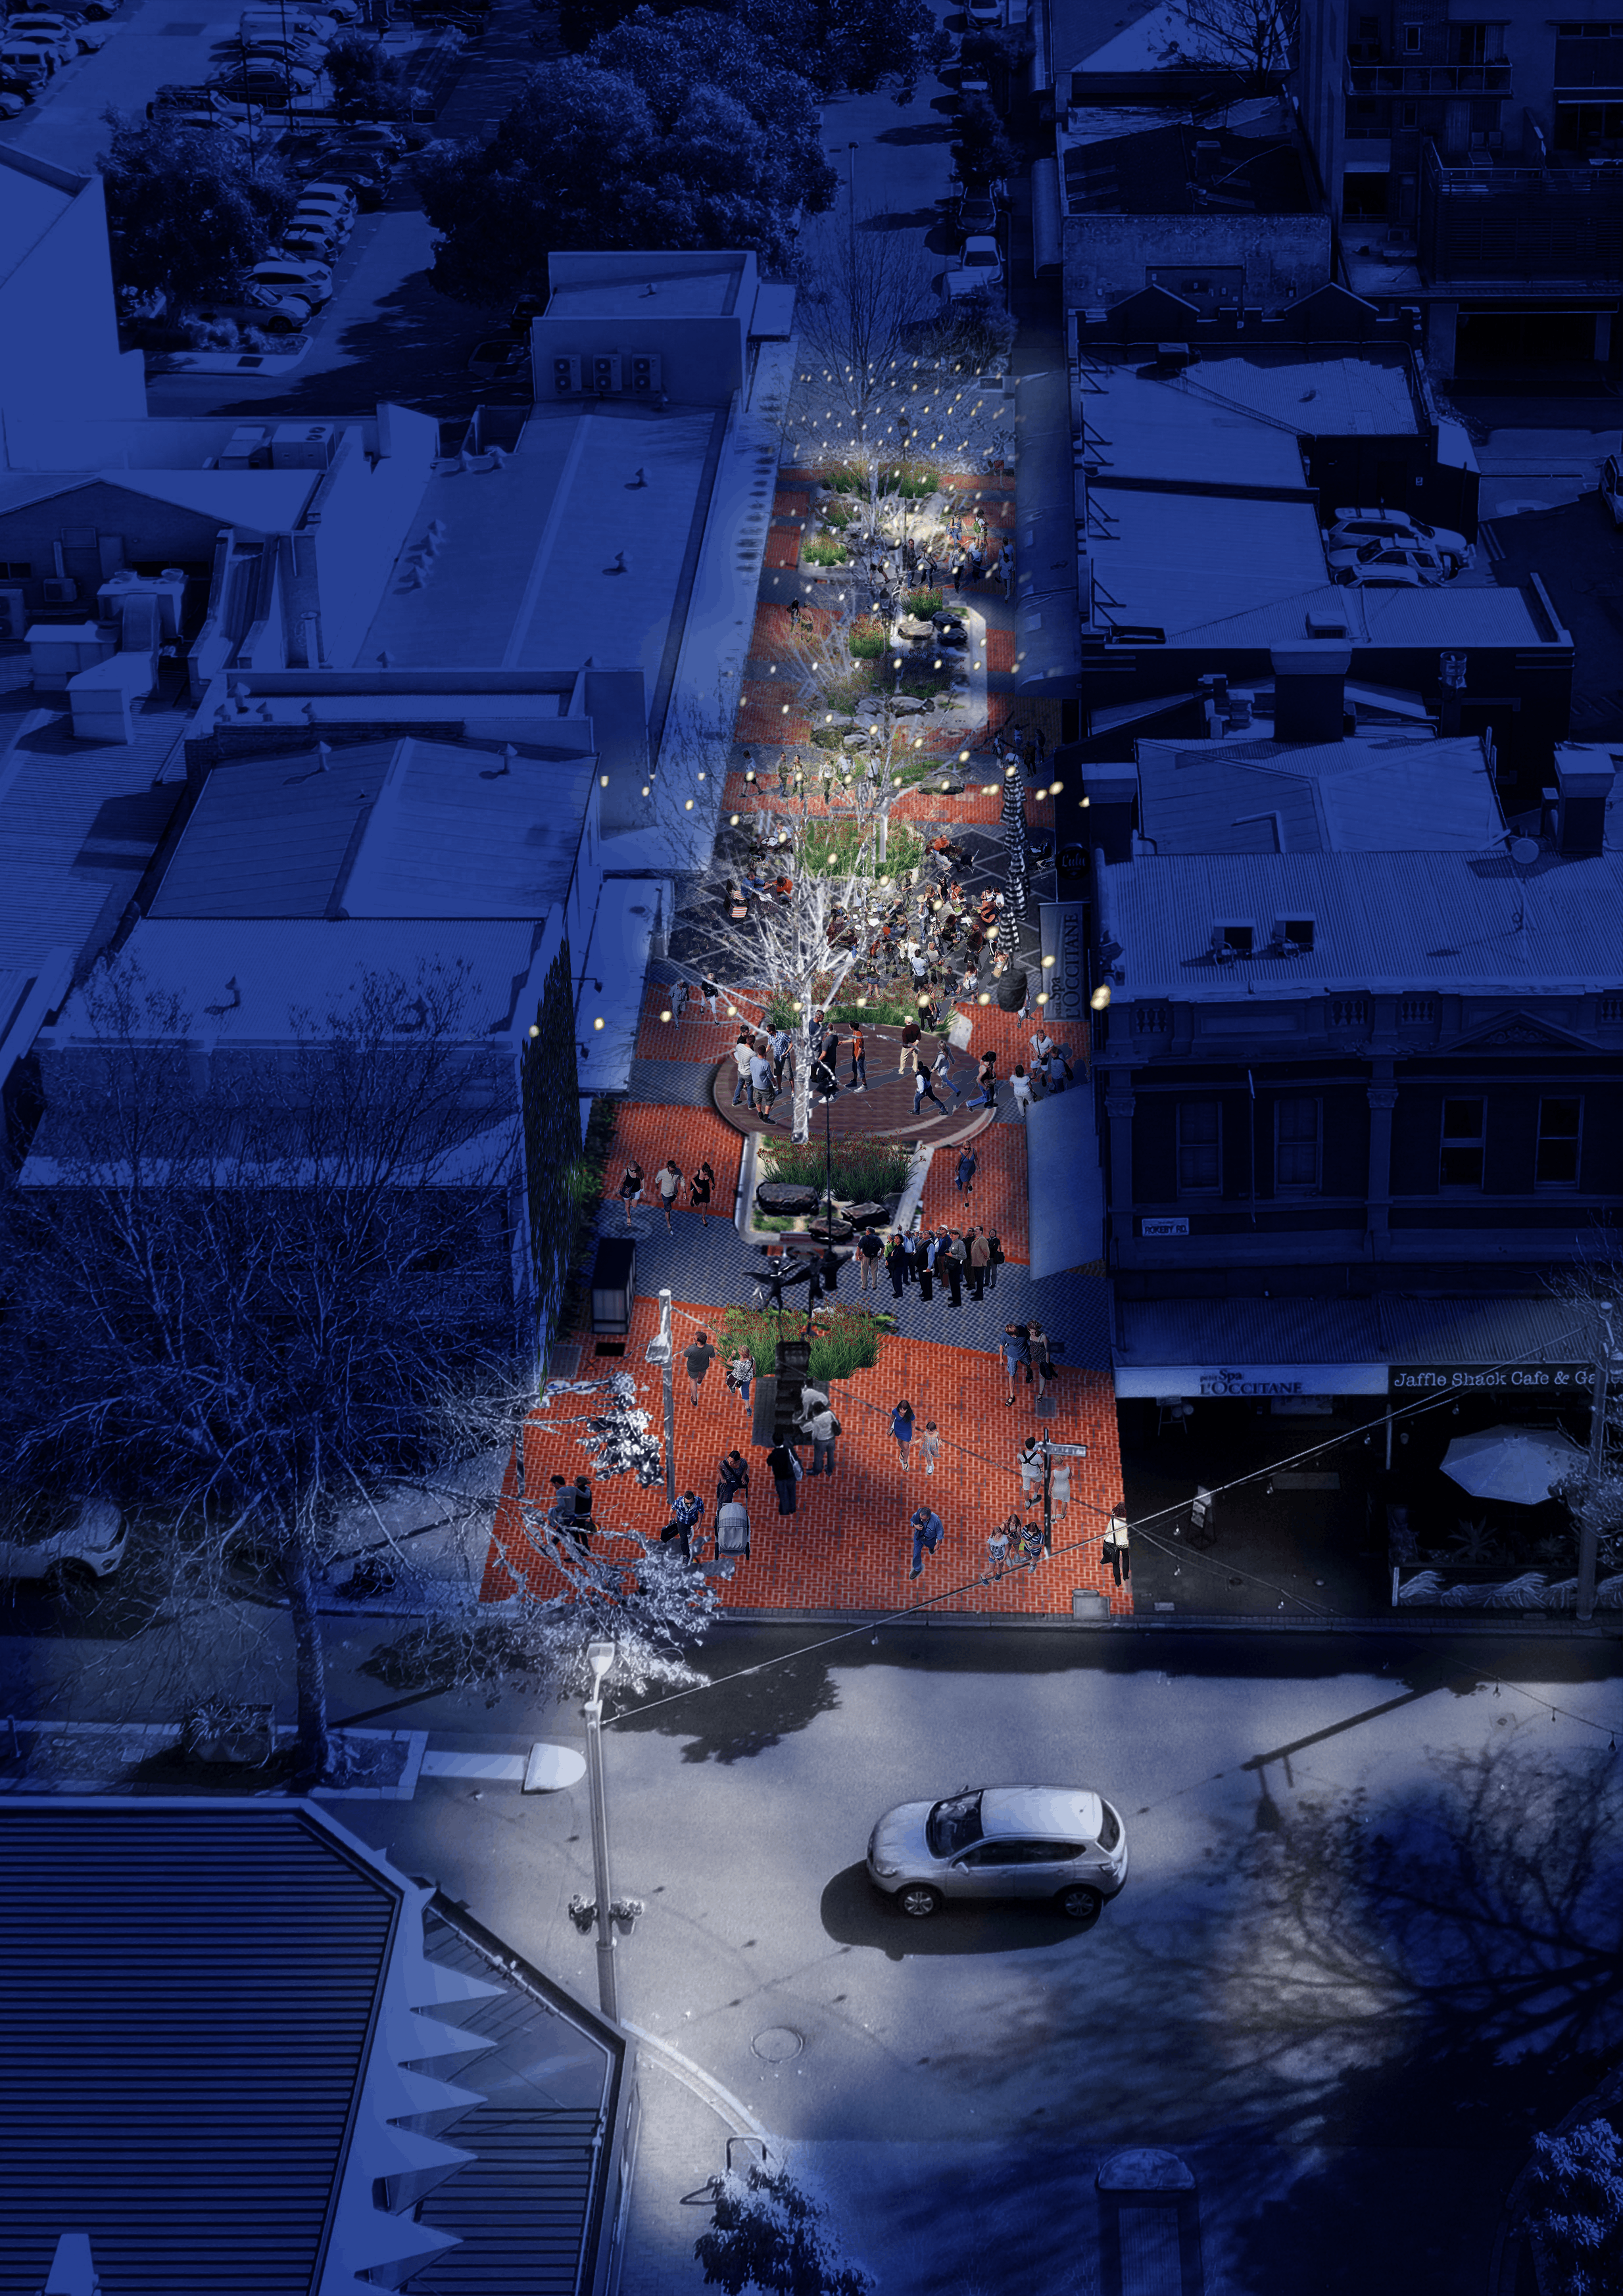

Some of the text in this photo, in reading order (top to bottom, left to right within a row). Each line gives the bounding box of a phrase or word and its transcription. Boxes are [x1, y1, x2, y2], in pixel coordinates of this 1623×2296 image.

[1062, 913, 1081, 1018] L'OCCITANE
[1049, 977, 1065, 1000] Spa
[1219, 1368, 1242, 1383] Spa
[1394, 1372, 1447, 1387] Jaffle
[1451, 1372, 1507, 1387] Shack
[1511, 1371, 1549, 1385] Cafe
[1554, 1371, 1570, 1385] &
[1200, 1381, 1302, 1395] L'OCCITANE
